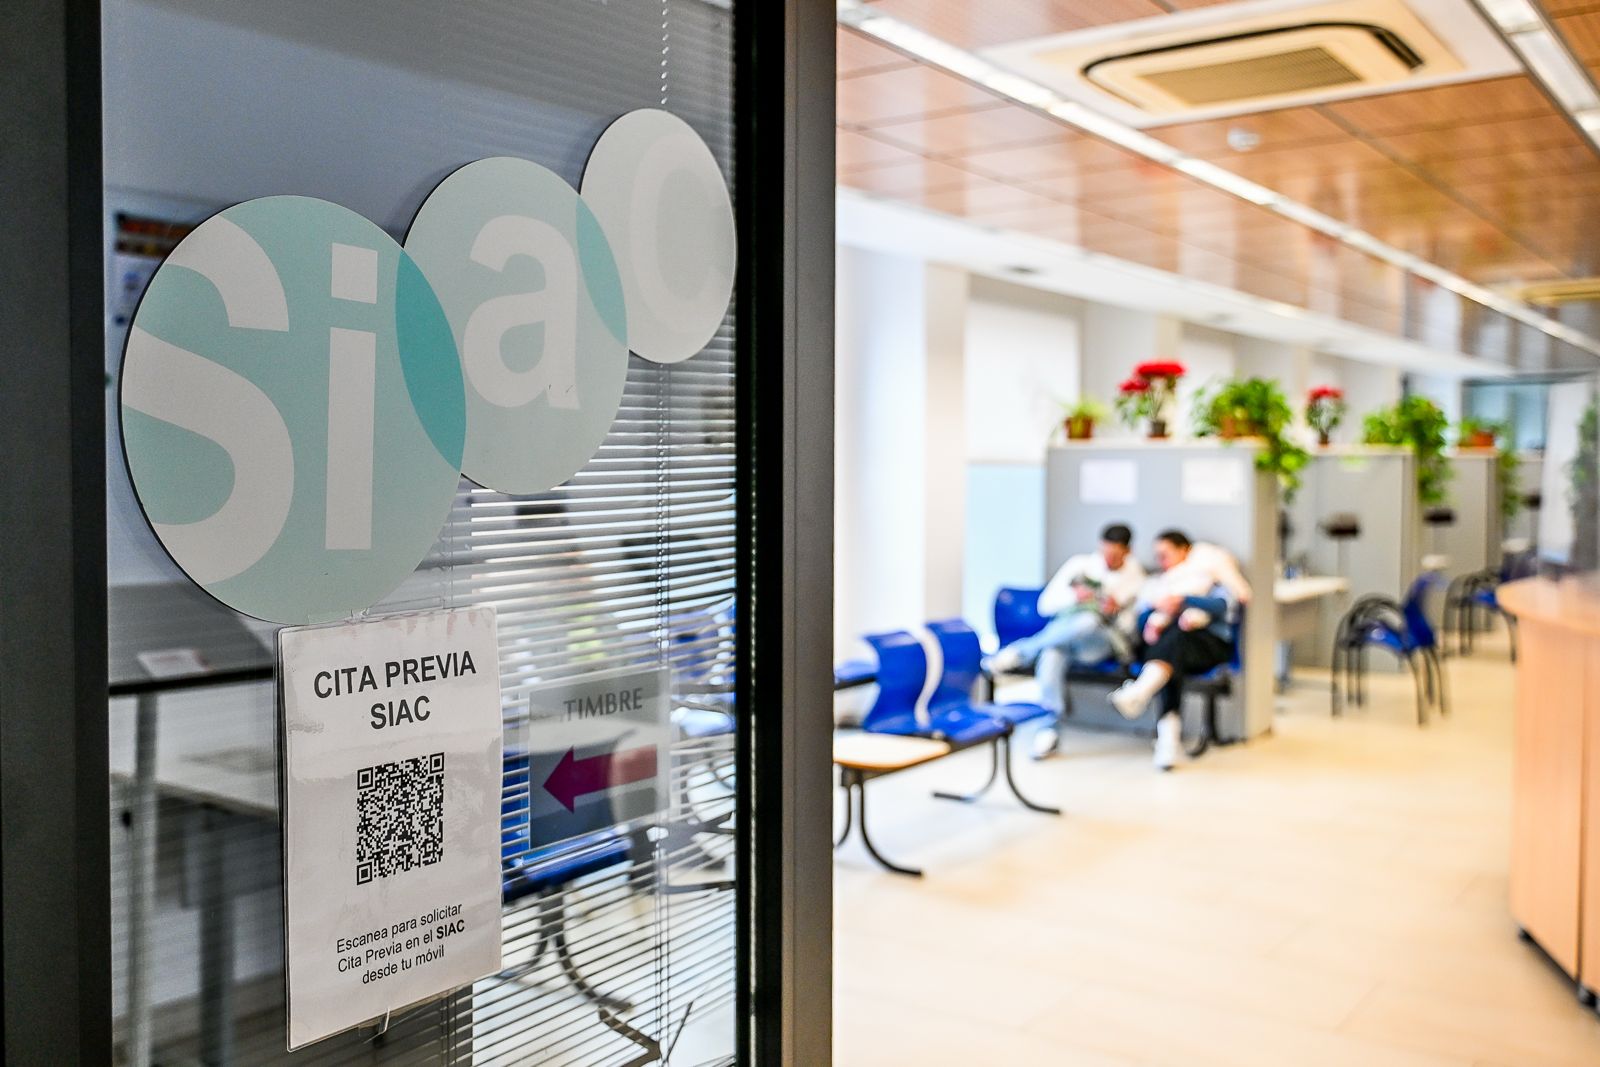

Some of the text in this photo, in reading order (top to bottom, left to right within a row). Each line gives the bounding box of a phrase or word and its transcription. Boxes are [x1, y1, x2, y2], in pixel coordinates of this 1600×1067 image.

[314, 650, 477, 699] CITA PREVIA
[370, 695, 431, 730] SIAC
[563, 687, 644, 722] TIMBRE
[336, 903, 462, 953] Escanea para solicitar
[337, 919, 465, 973] Cita Previa en el SIAC
[362, 944, 445, 984] desde tu móvil
